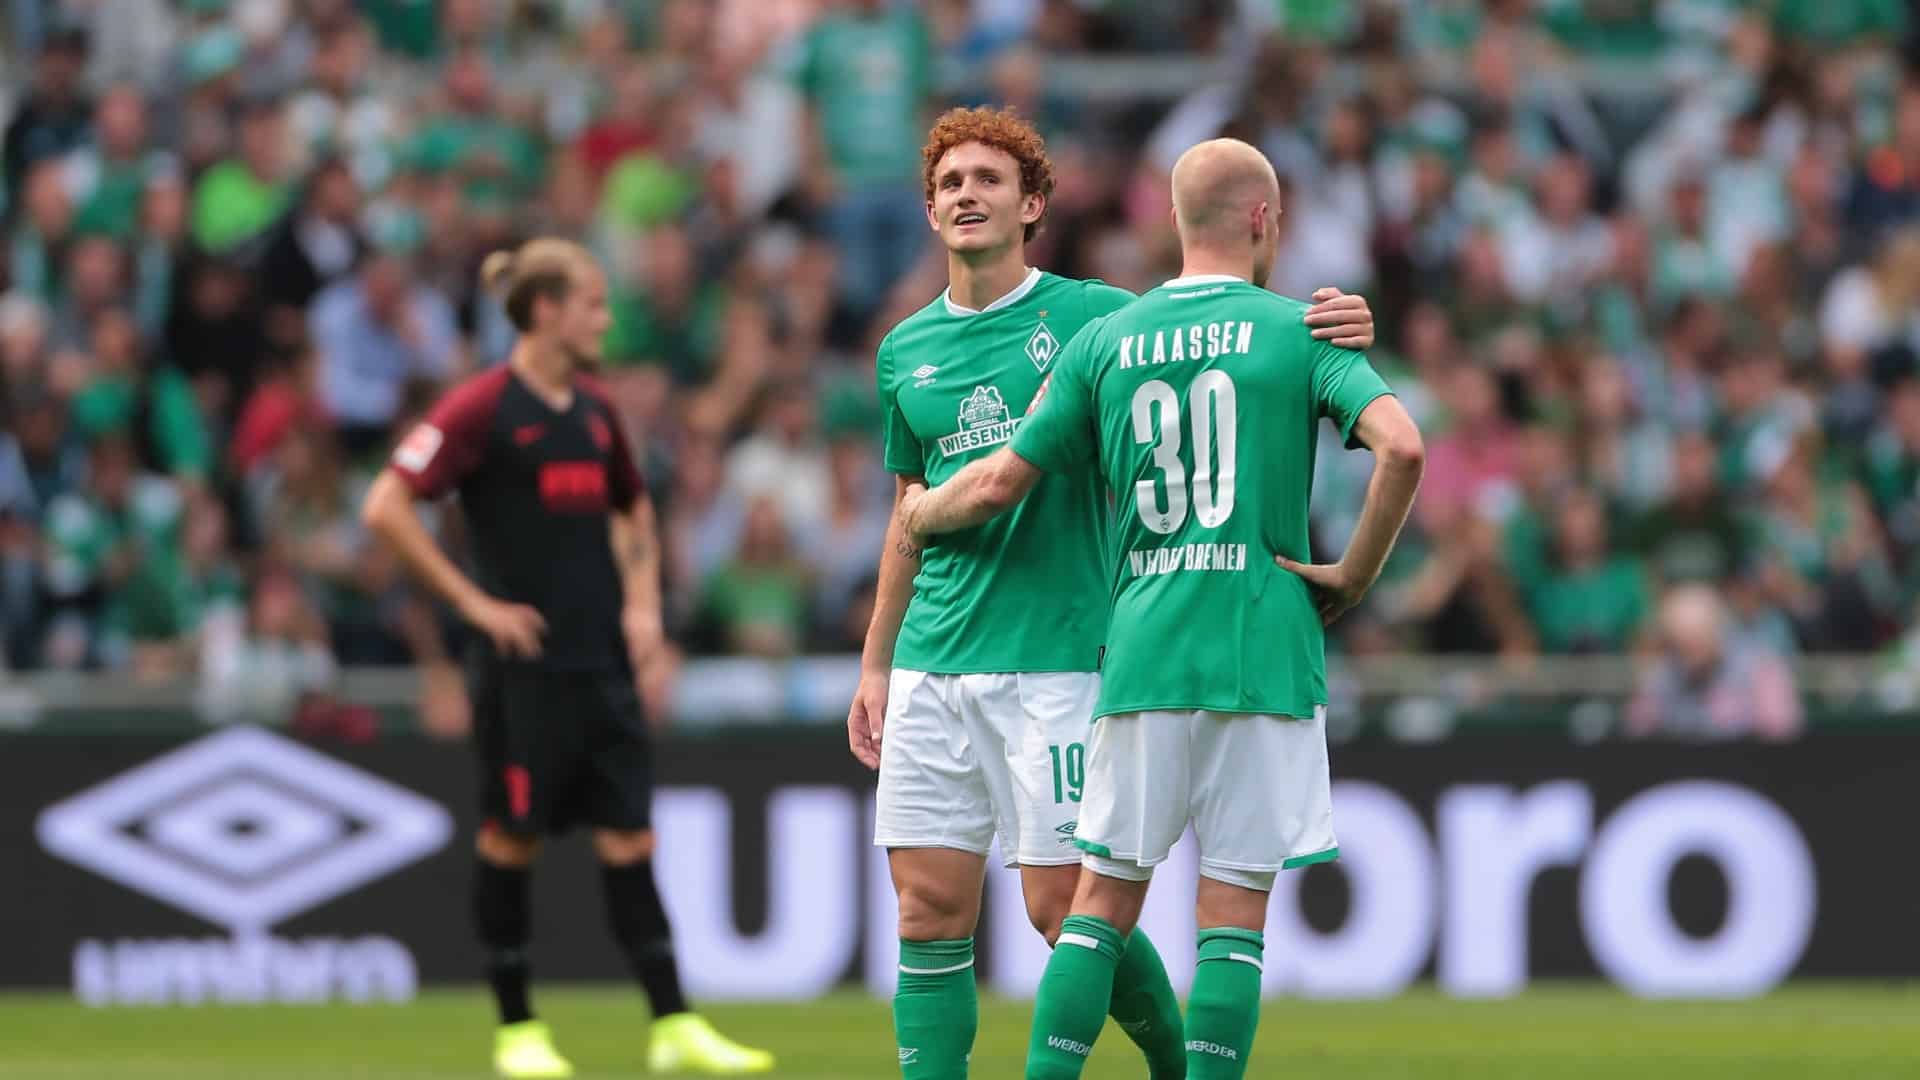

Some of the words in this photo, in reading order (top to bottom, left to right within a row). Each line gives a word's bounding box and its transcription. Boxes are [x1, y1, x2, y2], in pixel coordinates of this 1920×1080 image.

[1120, 321, 1253, 369] KLAASSEN
[941, 421, 1020, 454] WIESENH
[1131, 368, 1237, 534] 30
[1049, 743, 1084, 804] 19
